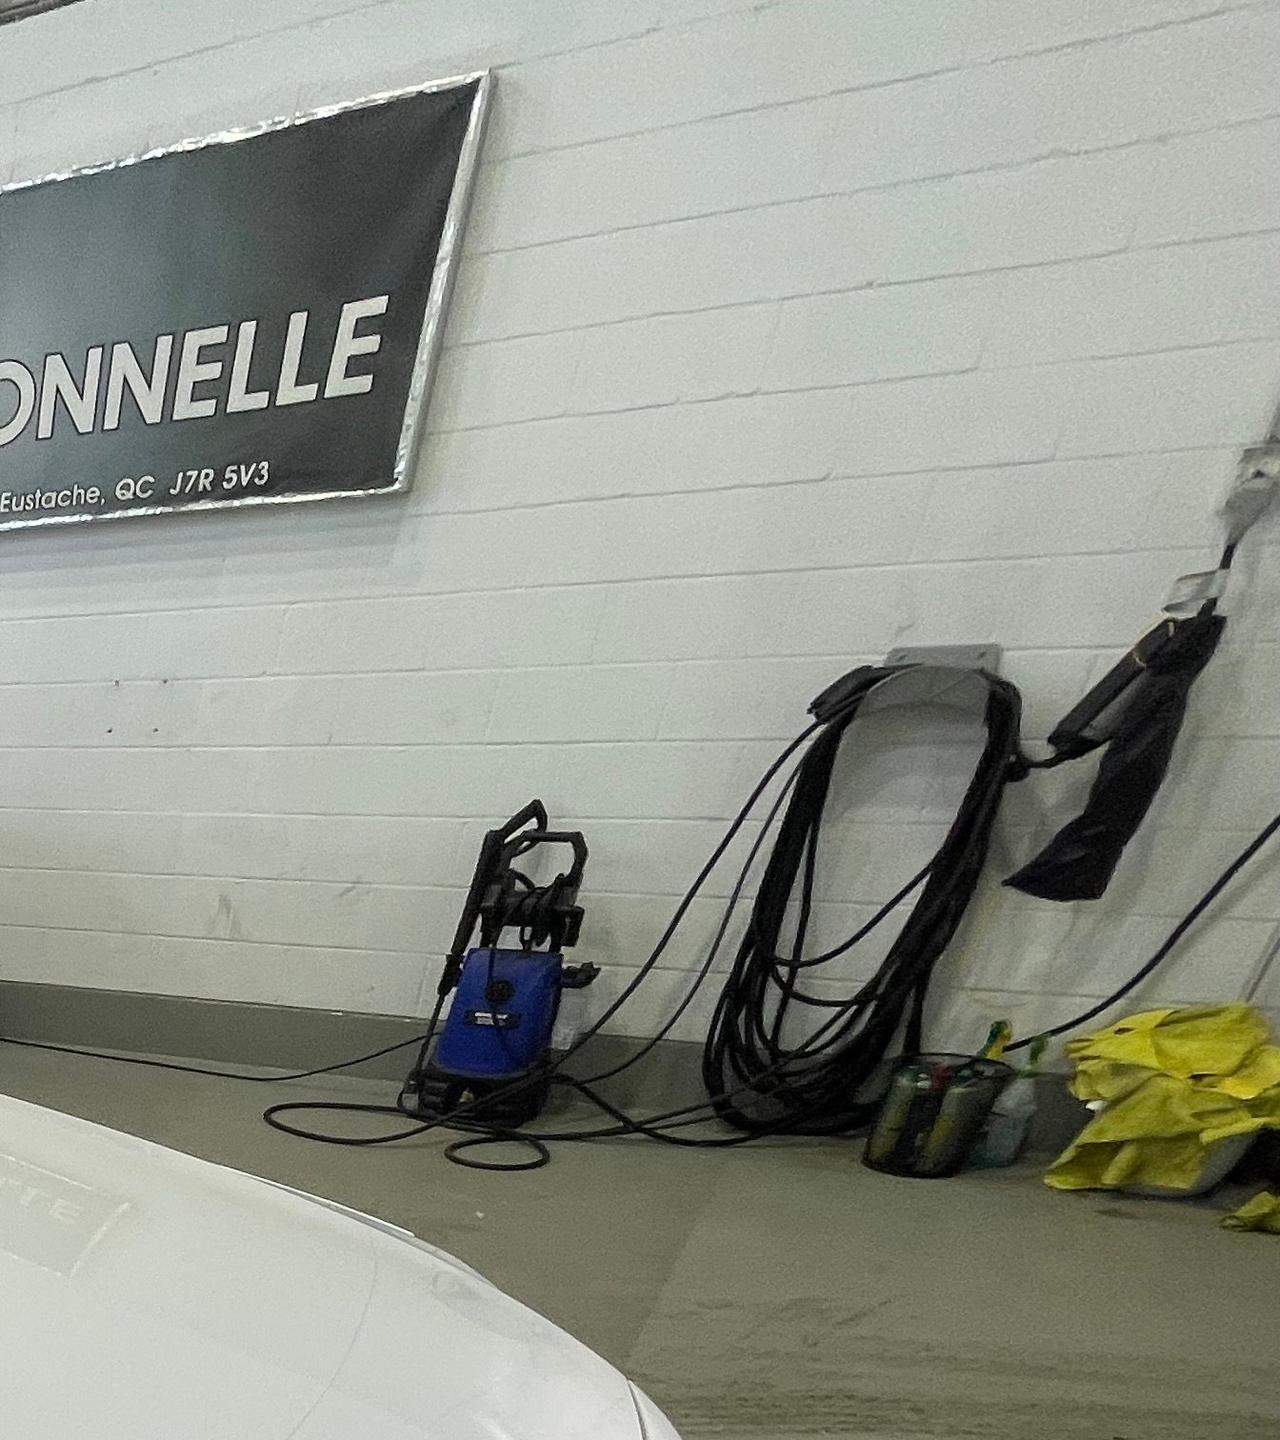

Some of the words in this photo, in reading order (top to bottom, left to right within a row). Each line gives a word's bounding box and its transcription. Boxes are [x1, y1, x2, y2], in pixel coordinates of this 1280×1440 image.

[114, 475, 157, 501] QC
[169, 468, 216, 497] J7R
[222, 460, 270, 491] 5V3
